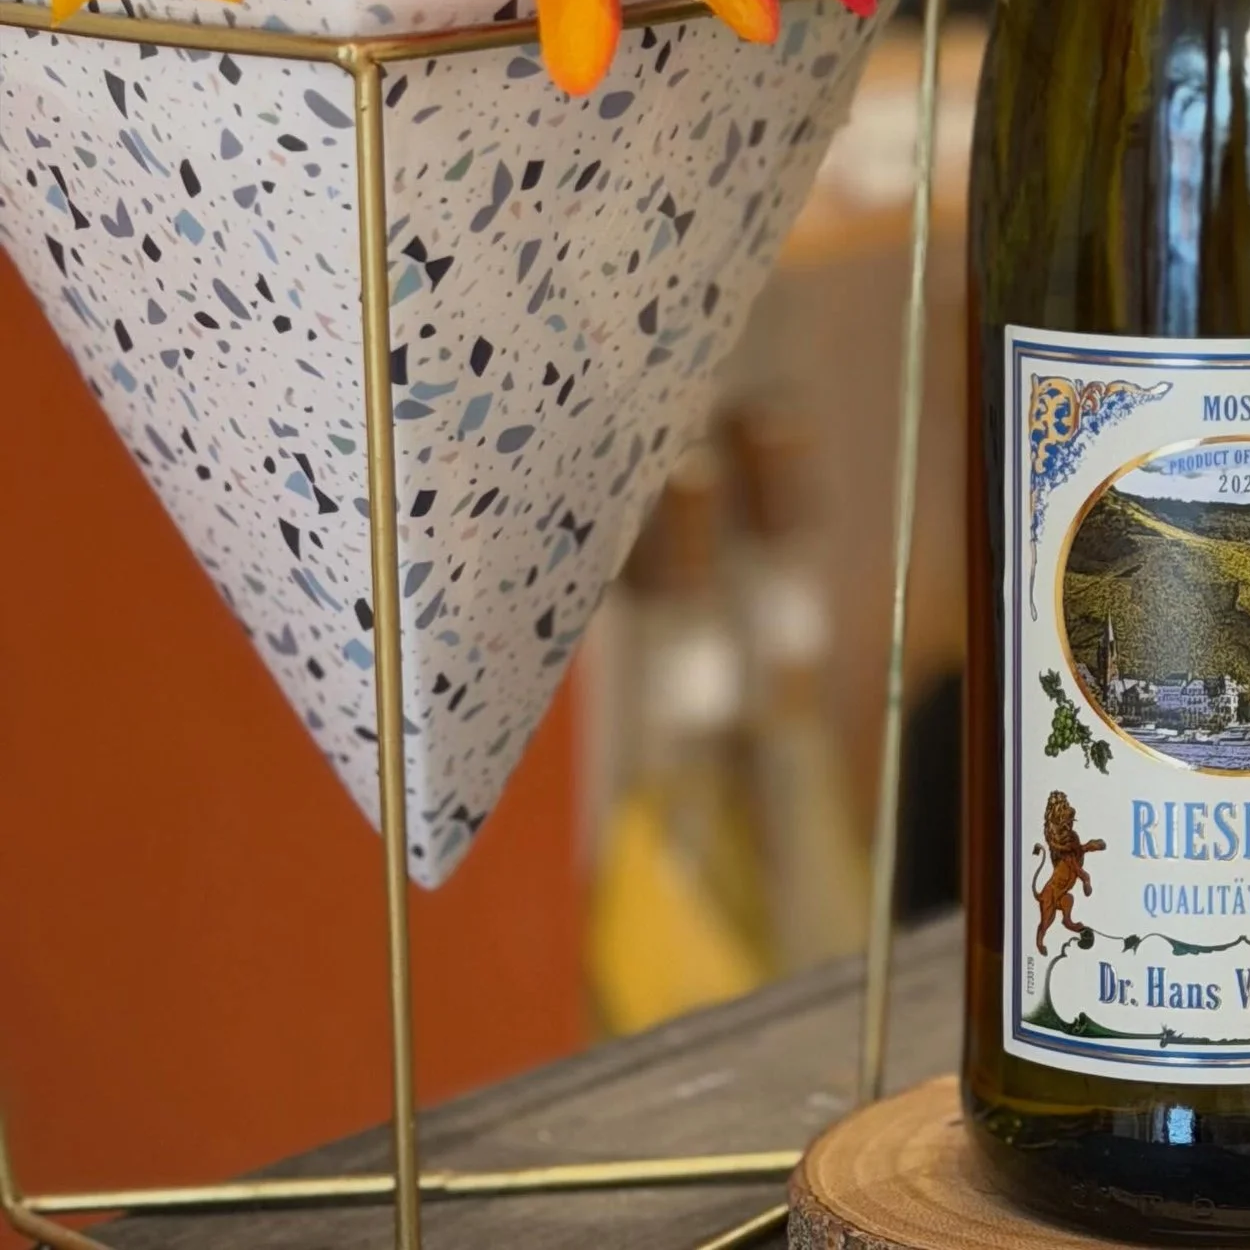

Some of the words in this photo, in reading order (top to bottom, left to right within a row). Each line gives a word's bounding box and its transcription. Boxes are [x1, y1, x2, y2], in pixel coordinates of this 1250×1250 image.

[1169, 450, 1230, 476] PRODUCT
[1234, 449, 1250, 465] OF
[1098, 961, 1140, 1007] Dr.
[1146, 965, 1223, 1011] Hans
